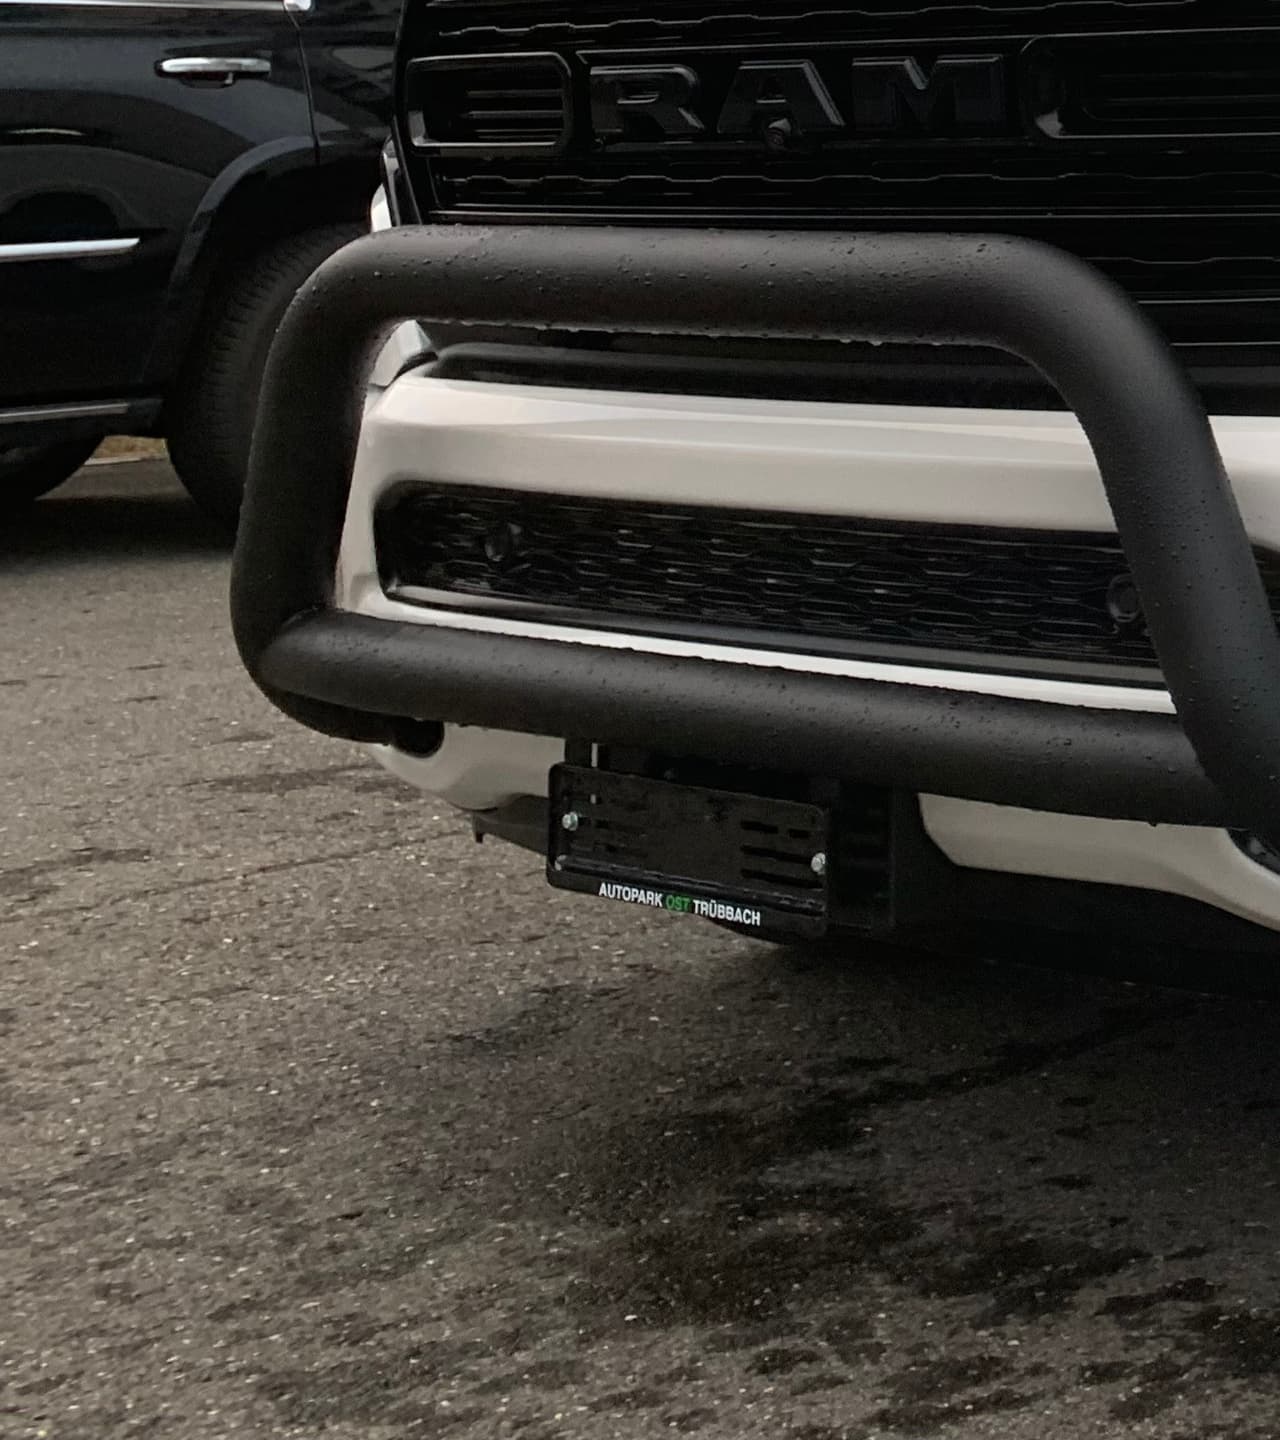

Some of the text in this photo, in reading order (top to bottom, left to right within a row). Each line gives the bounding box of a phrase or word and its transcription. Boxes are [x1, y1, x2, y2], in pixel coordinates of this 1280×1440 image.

[588, 54, 1000, 137] RAM
[599, 883, 761, 926] AUTOPARK OST TRÜBBACH
